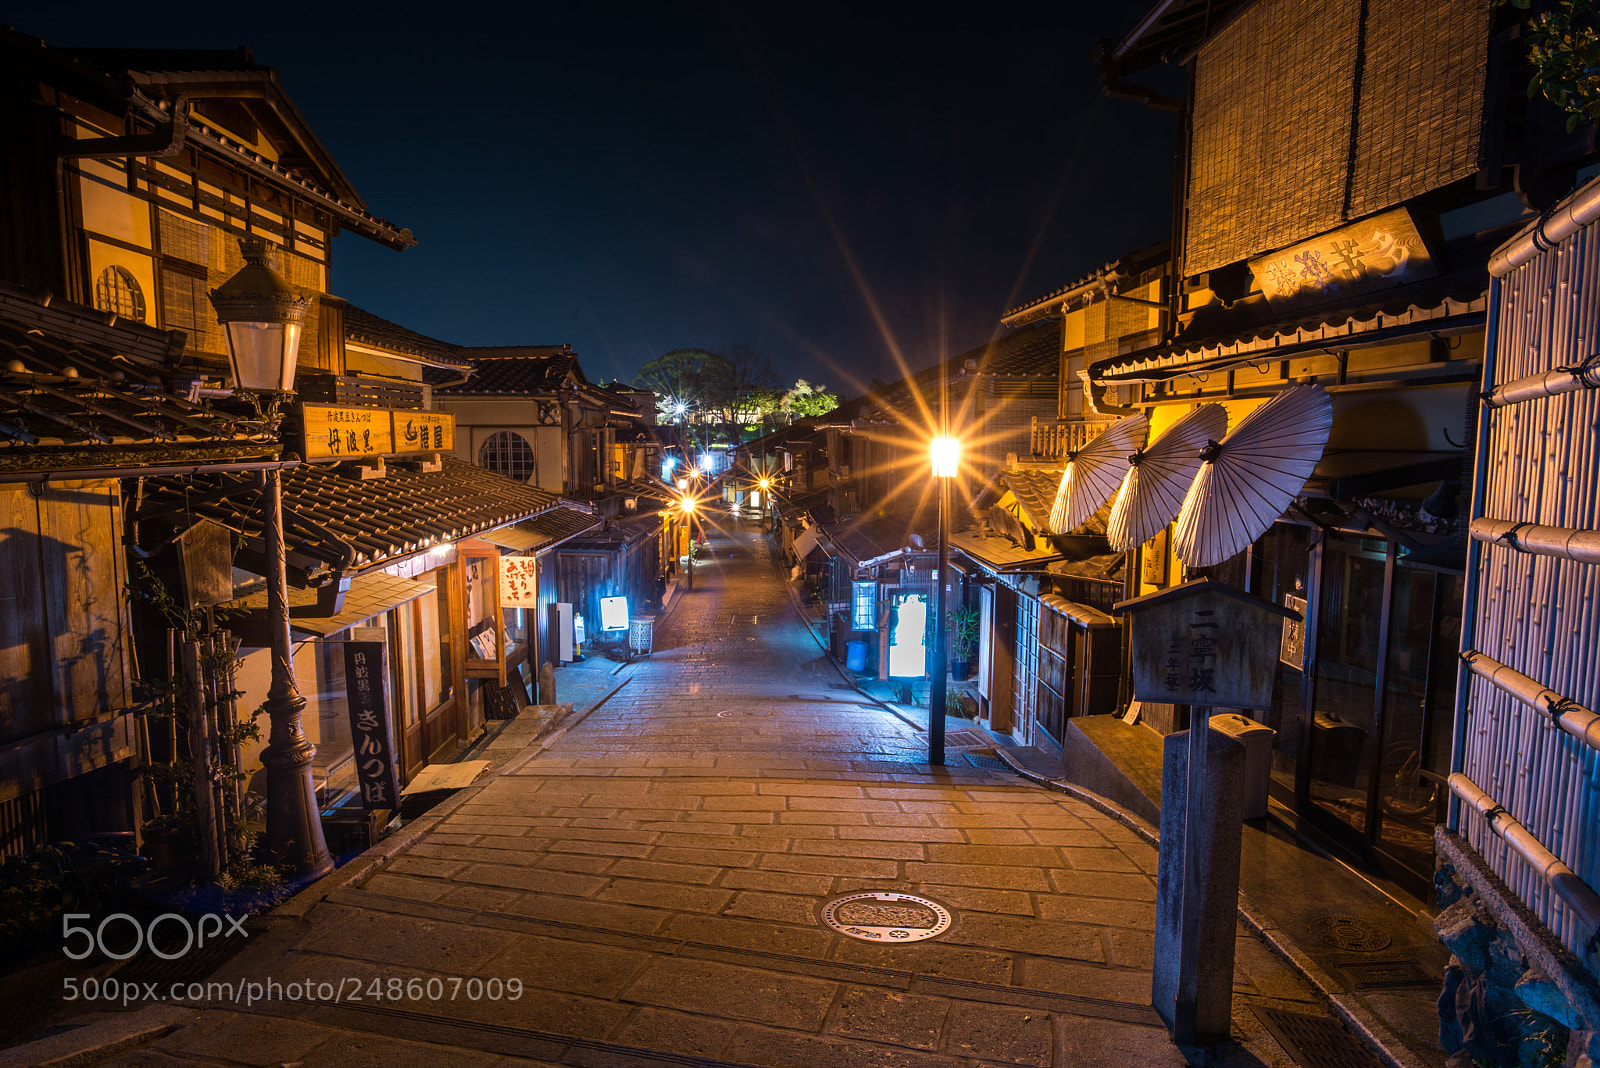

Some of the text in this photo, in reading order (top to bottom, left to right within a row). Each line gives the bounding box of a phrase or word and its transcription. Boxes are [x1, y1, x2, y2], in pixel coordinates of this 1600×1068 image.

[328, 427, 374, 455] 丹波黒
[506, 561, 521, 601] あげもち
[519, 560, 528, 590] もっちり
[1188, 609, 1220, 693] 二寧坂
